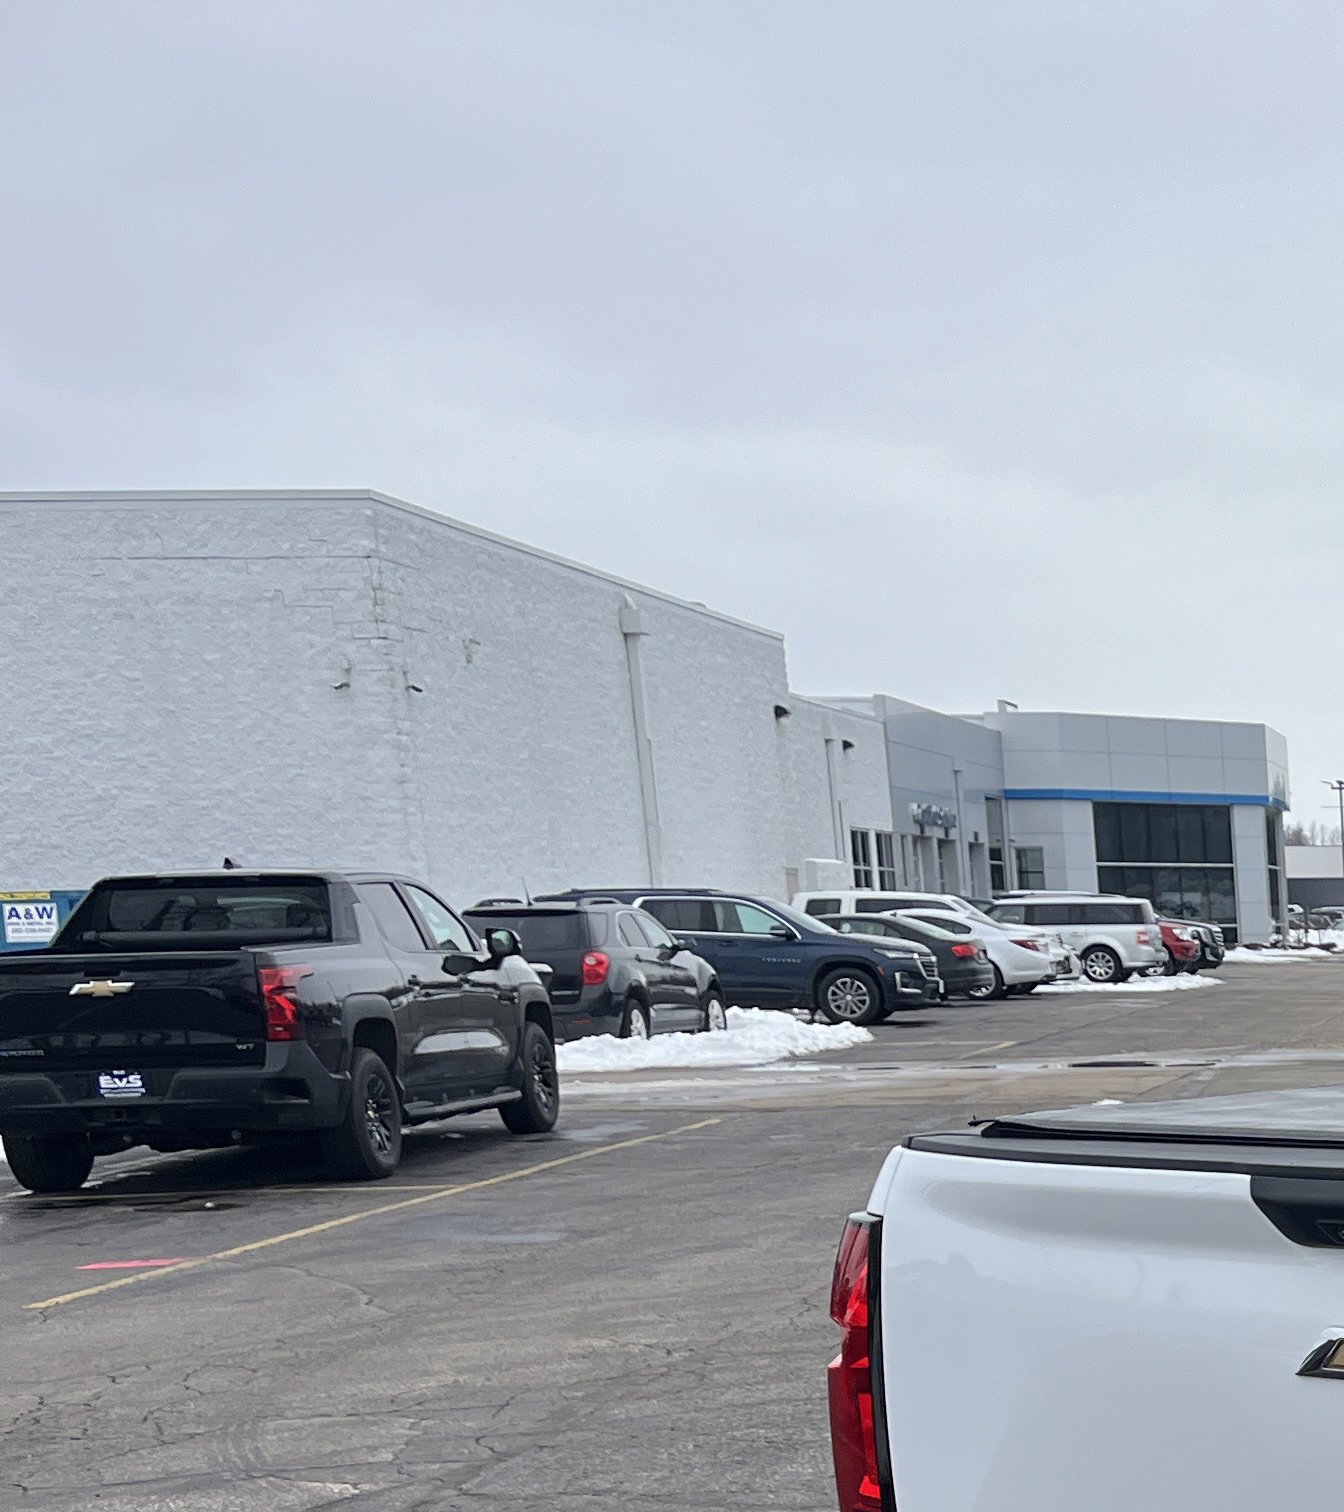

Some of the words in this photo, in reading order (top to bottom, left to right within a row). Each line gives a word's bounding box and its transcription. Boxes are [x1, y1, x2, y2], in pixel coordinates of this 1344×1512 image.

[8, 907, 21, 919] A
[24, 908, 34, 919] &
[35, 906, 53, 919] W
